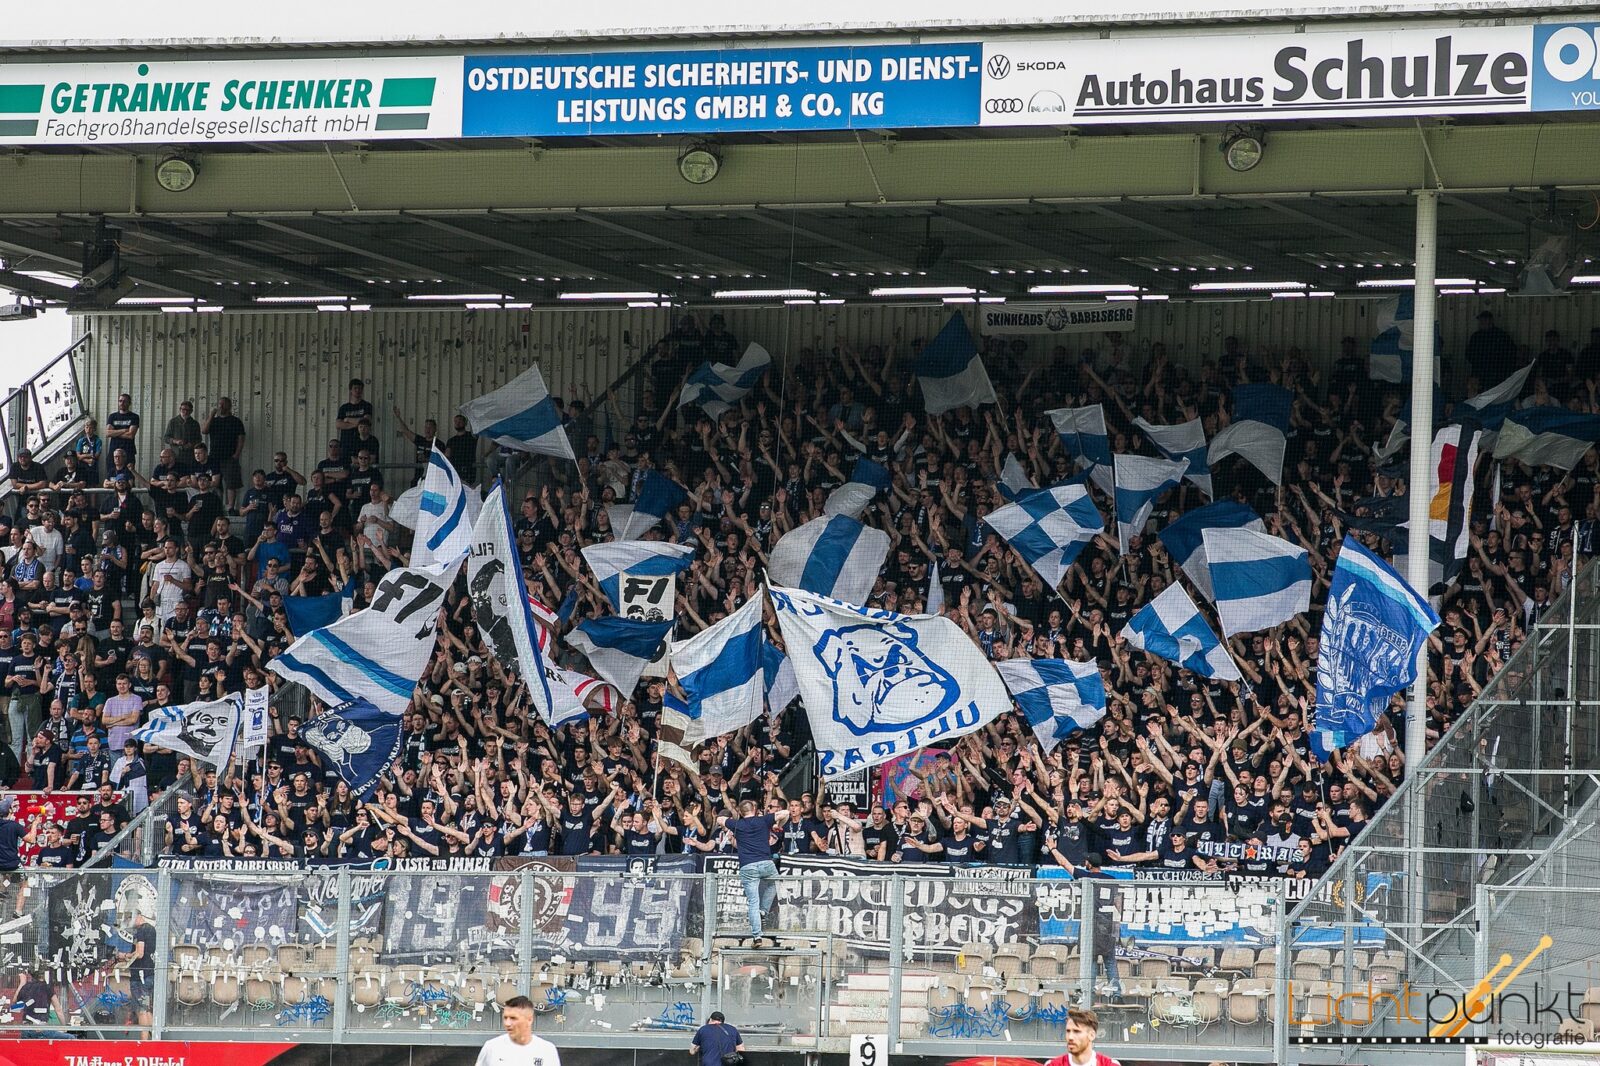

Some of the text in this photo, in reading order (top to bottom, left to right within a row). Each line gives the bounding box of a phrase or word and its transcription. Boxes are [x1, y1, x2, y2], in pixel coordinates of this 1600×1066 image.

[1543, 26, 1600, 82] O
[468, 54, 979, 92] OSTDEUTSCHE SICHERHEITS- UND DIENST-
[1076, 35, 1528, 107] Autohaus Schulze
[221, 79, 373, 112] SCHENKER
[556, 91, 886, 123] LEISTUNGS GMBH & CO. KG
[45, 113, 371, 141] Fachgroßhandelsgesellschaft mbH
[986, 307, 1133, 327] SKINHEADS BABELSBERG
[448, 857, 491, 872] IMMER
[860, 1042, 876, 1066] 9
